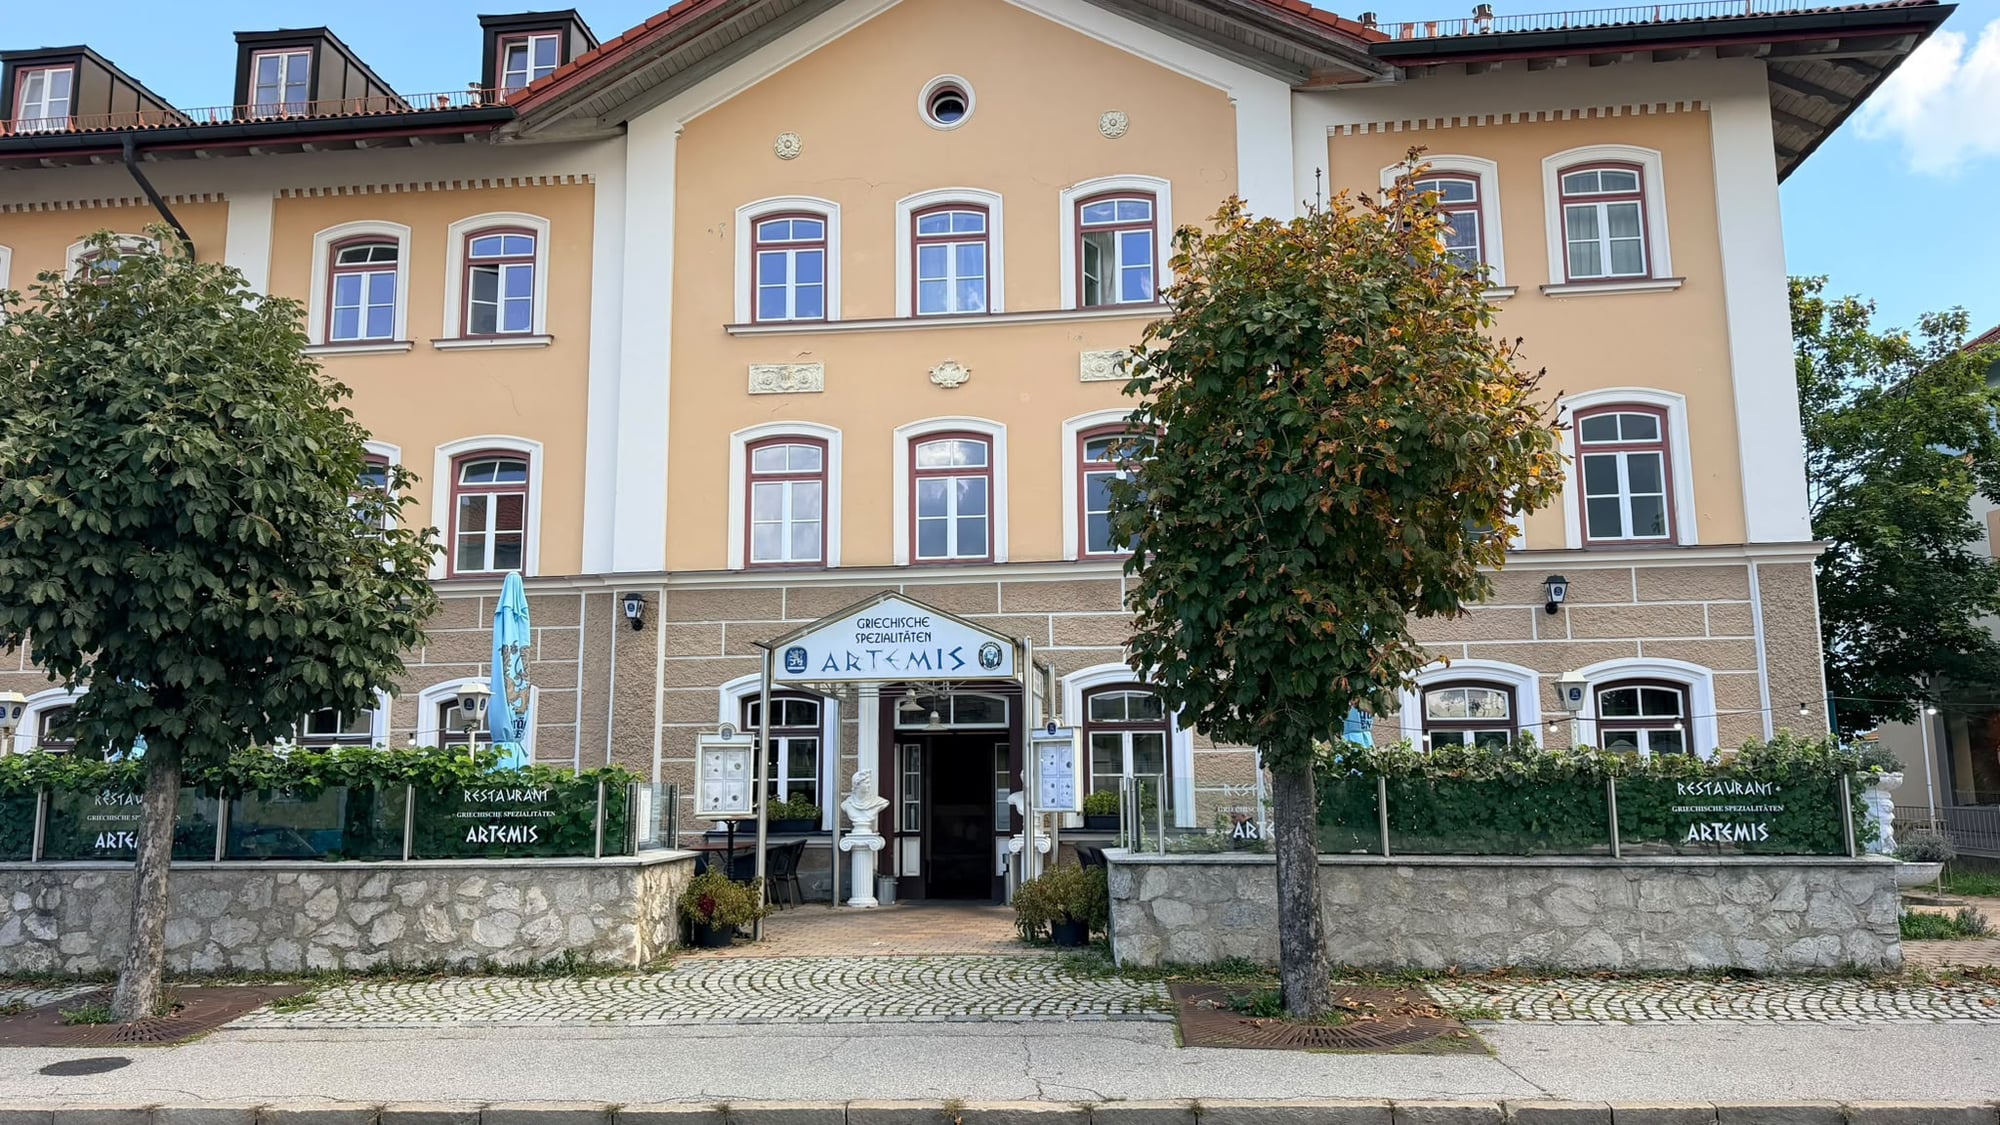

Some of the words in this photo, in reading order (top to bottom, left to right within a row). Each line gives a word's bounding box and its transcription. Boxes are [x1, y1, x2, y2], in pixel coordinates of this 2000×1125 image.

[857, 616, 930, 629] GRIECHISCHE
[855, 630, 932, 644] SPEZIALITÄTEN
[821, 646, 966, 672] ARTEMIS
[464, 788, 550, 802] RESTAURANT
[1677, 780, 1773, 796] RESTAURANT
[94, 792, 143, 806] RESTAU
[503, 809, 556, 818] SPEZIALITÄTEN
[1672, 805, 1724, 813] GRIECHISCHE
[1724, 804, 1784, 812] SPEZIALITÄTEN
[465, 825, 538, 843] ARTEMIS
[1233, 820, 1276, 840] ARTE
[1688, 822, 1769, 842] ARTEMIS
[94, 831, 139, 849] ARTE
